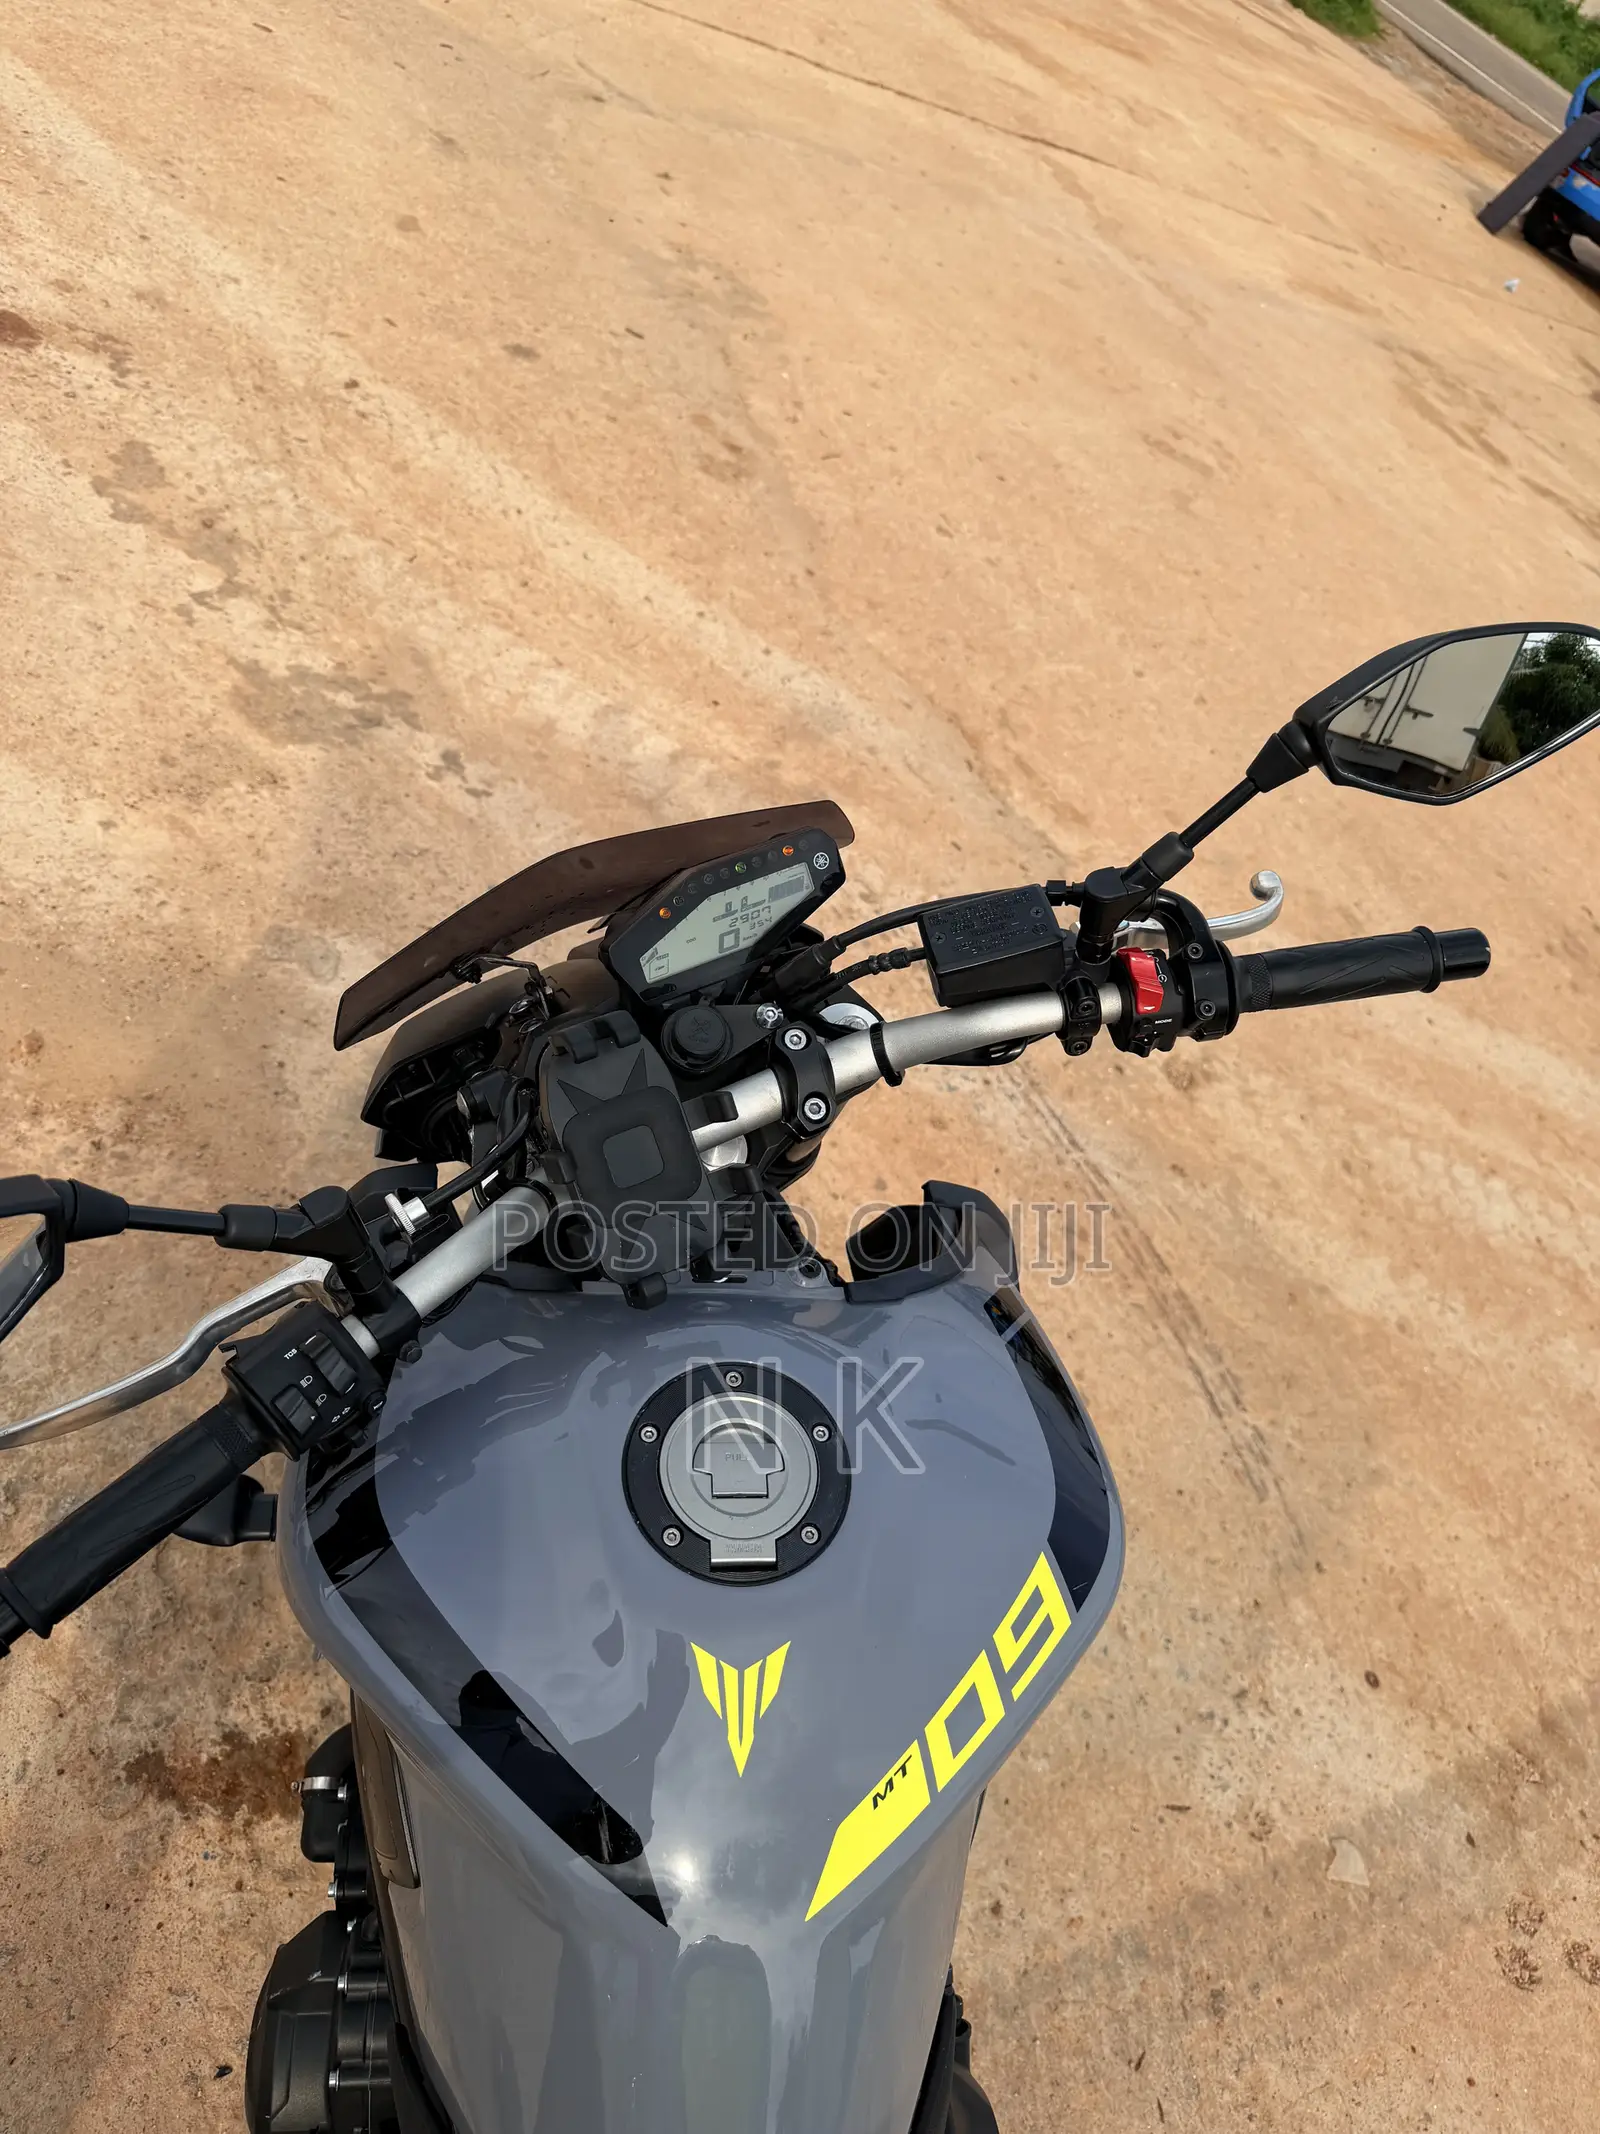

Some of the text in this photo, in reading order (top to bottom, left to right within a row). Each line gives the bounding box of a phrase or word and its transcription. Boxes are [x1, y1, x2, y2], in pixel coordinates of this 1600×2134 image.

[729, 905, 771, 928] 2907
[719, 927, 740, 954] 0
[284, 1348, 298, 1360] TCS
[724, 1452, 752, 1463] PUL
[872, 1551, 1072, 1811] MT 09
